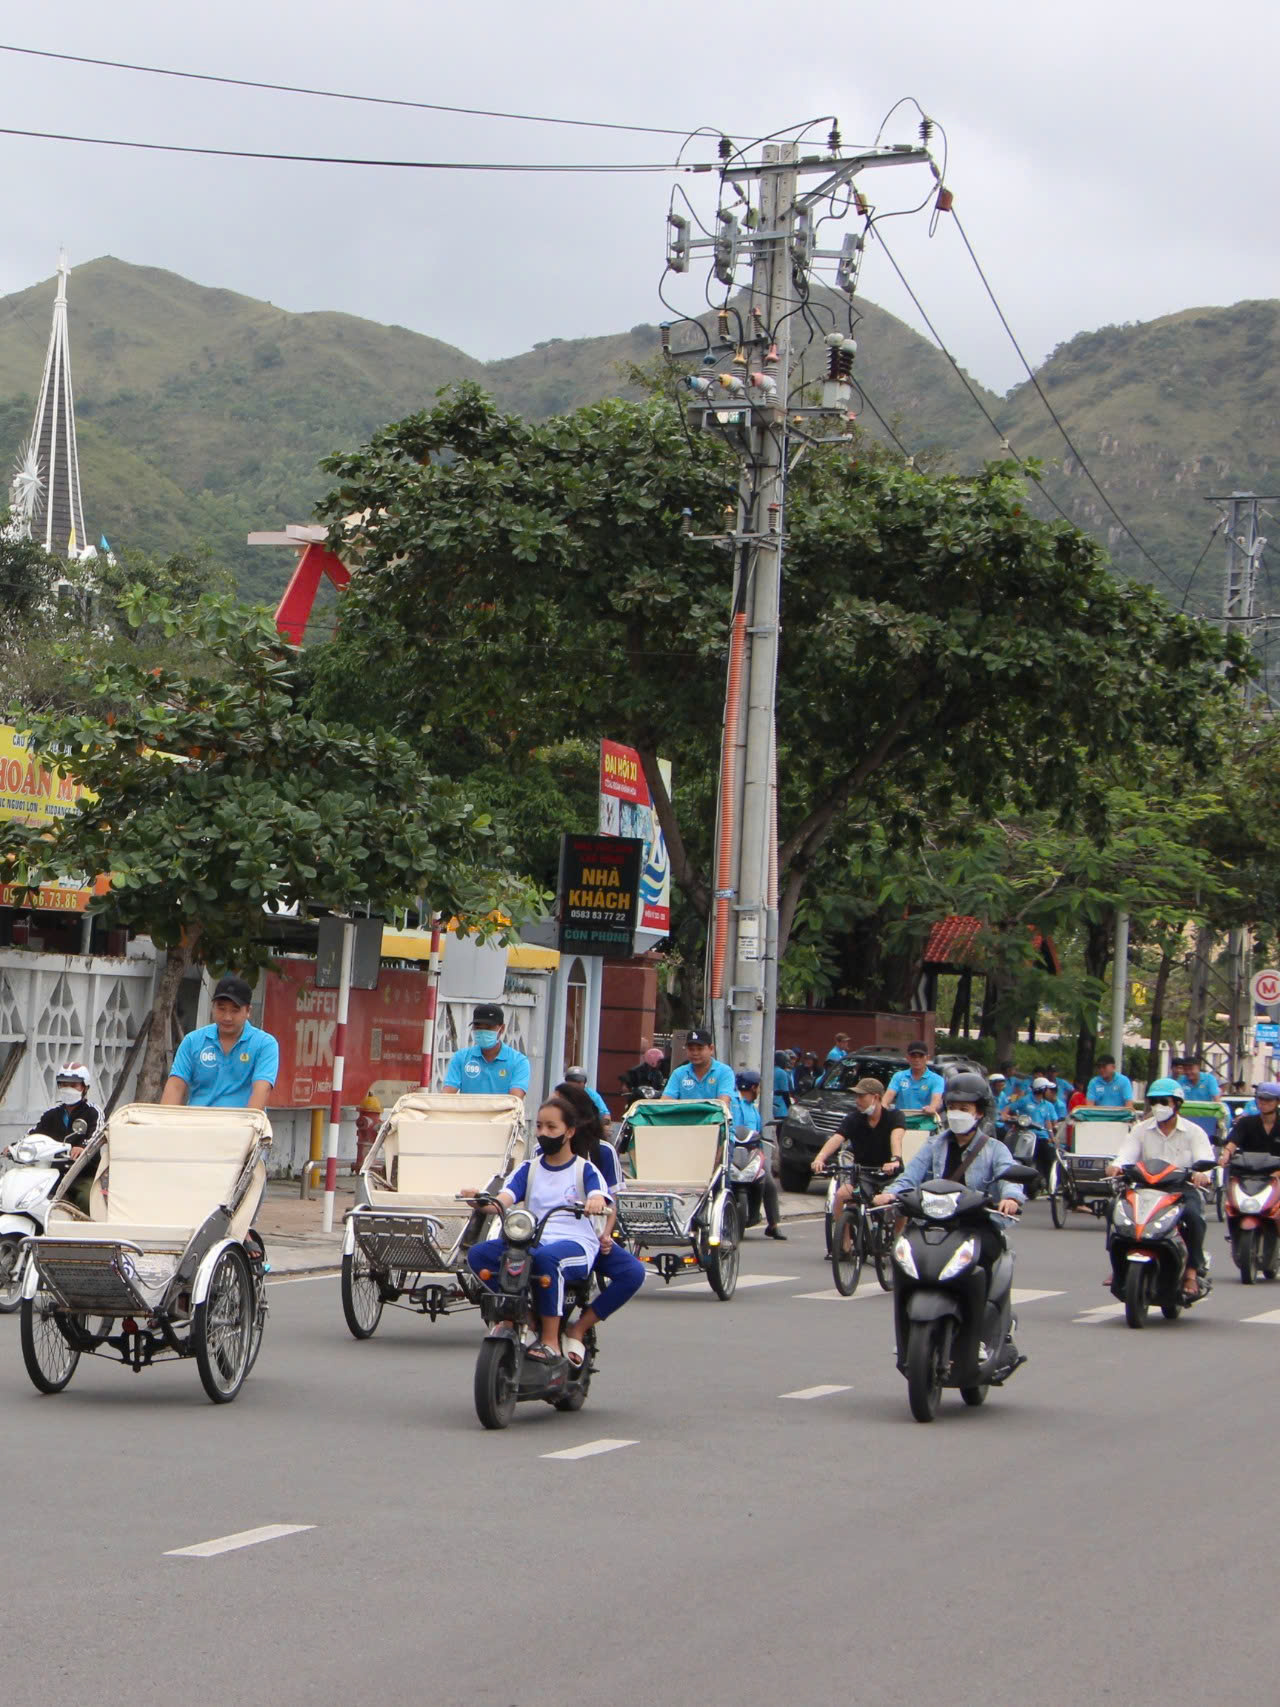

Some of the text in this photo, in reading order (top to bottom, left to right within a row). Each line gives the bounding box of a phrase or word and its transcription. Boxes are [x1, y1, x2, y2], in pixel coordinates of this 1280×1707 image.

[582, 867, 620, 887] NHÀ
[568, 888, 631, 909] KHÁCH
[604, 912, 613, 920] 77
[616, 913, 626, 921] 22
[296, 991, 337, 1014] BUFFET
[295, 1018, 337, 1068] 10K
